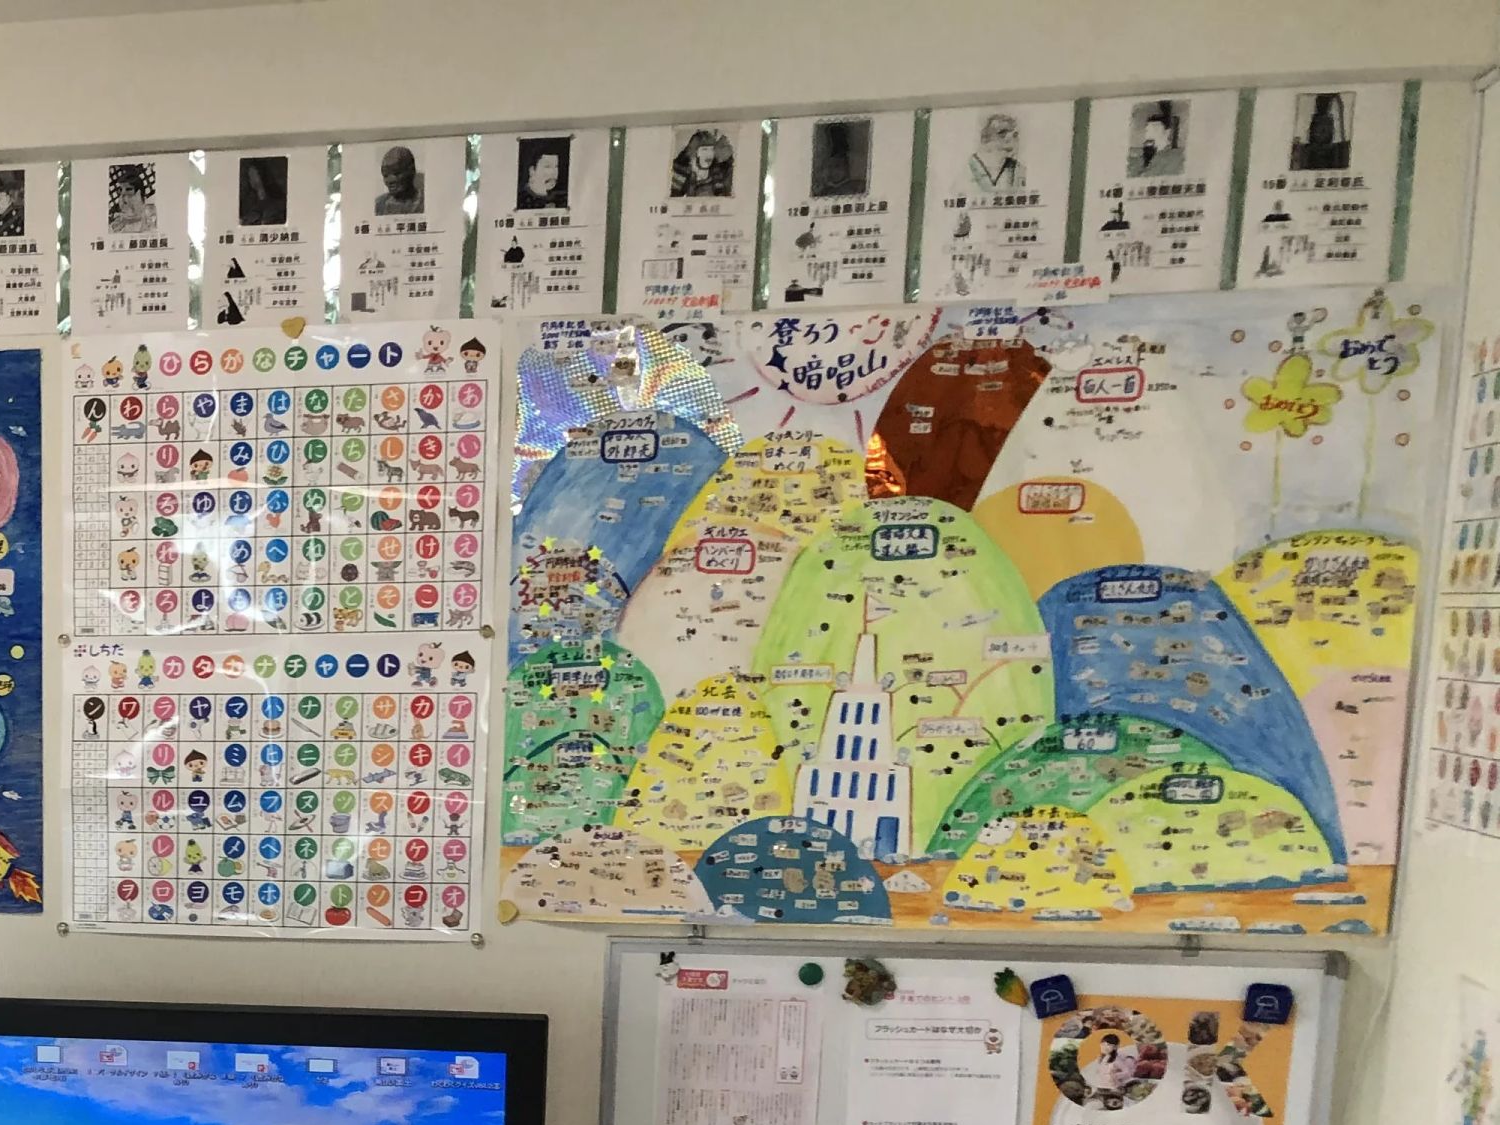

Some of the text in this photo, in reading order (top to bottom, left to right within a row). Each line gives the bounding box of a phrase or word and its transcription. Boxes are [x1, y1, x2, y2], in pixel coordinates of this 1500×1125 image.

[768, 317, 839, 349] 登ろう
[162, 346, 398, 373] ひらがなチャート
[793, 349, 888, 391] 暗唱山
[88, 643, 125, 658] しちだ
[166, 657, 396, 676] カタカナチャート
